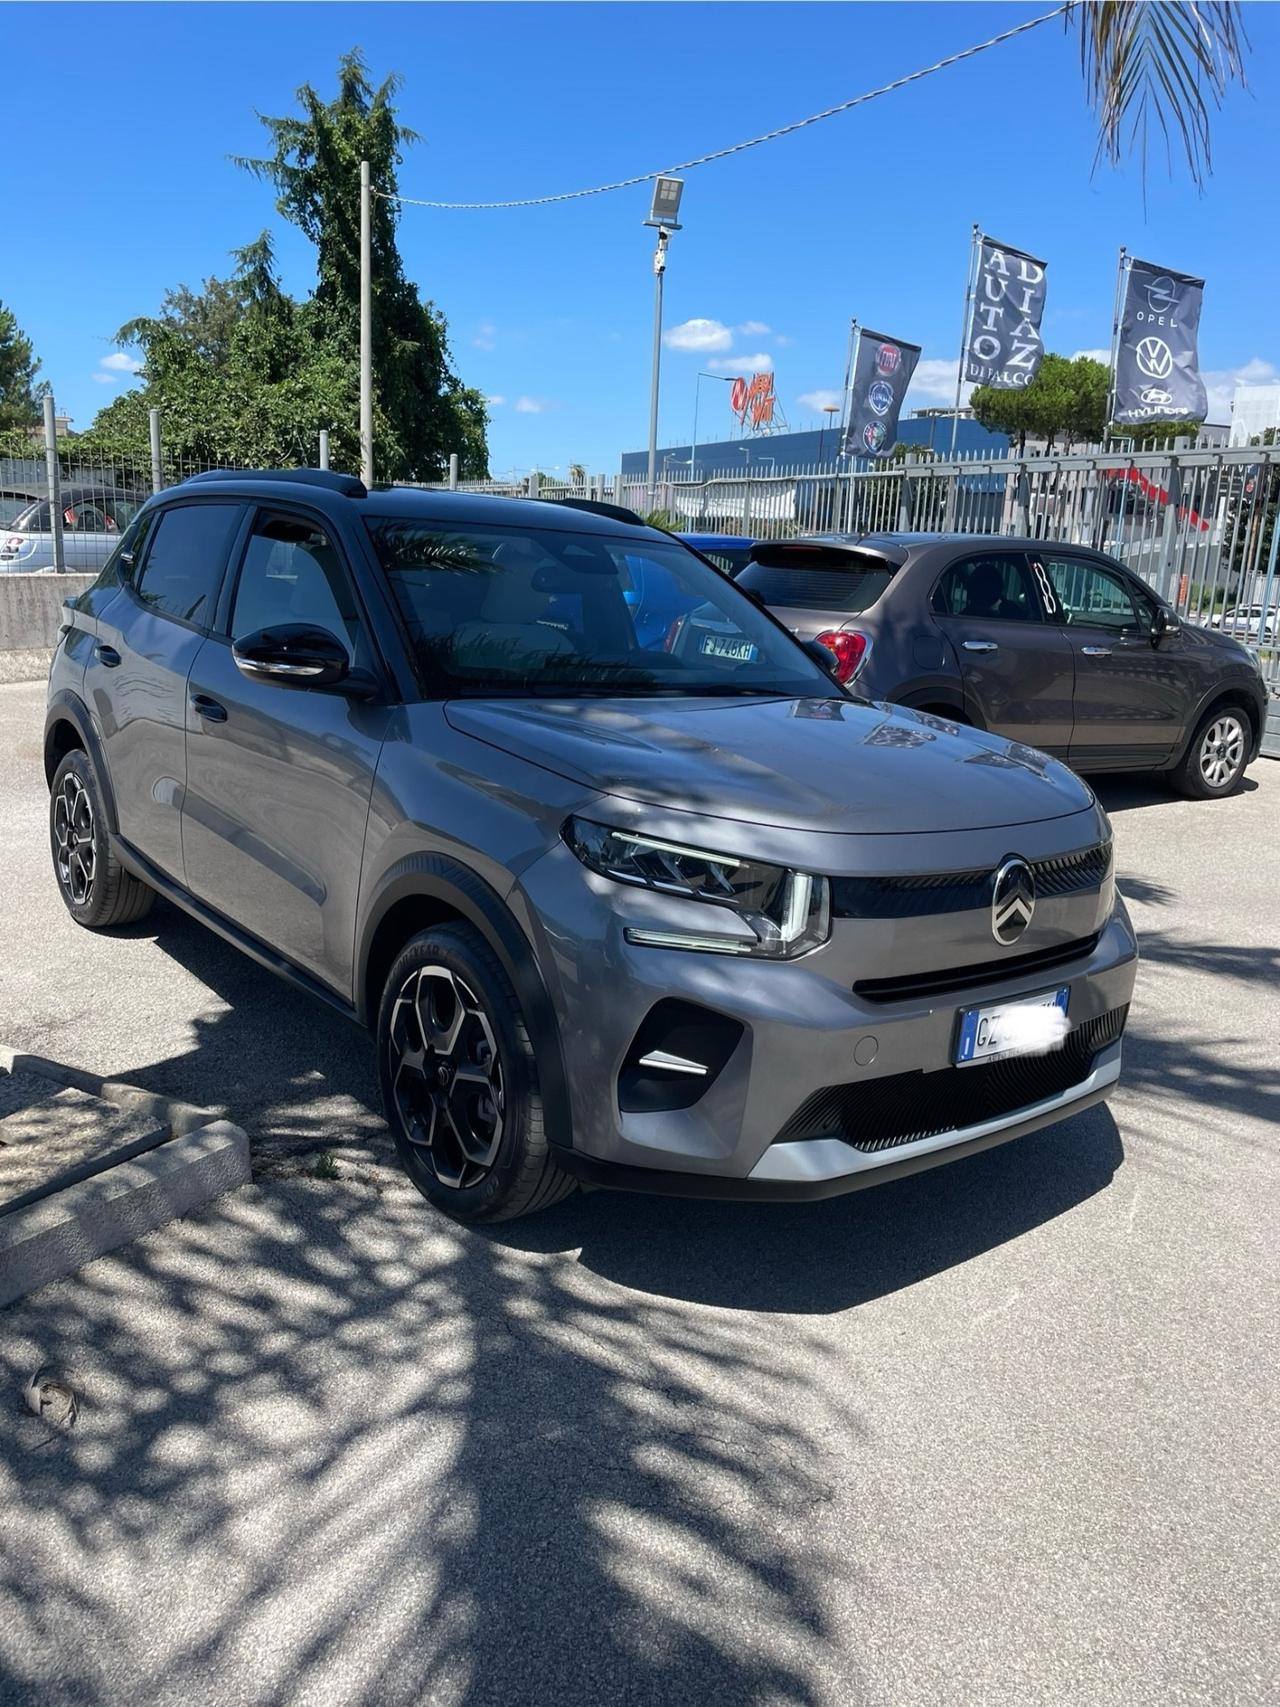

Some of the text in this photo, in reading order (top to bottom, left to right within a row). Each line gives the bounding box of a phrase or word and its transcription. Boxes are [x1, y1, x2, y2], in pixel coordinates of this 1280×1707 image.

[973, 249, 1010, 360] AUTO
[1006, 261, 1043, 371] DIAZ
[1136, 311, 1178, 328] OPEL
[1128, 405, 1189, 418] HYUNDAI
